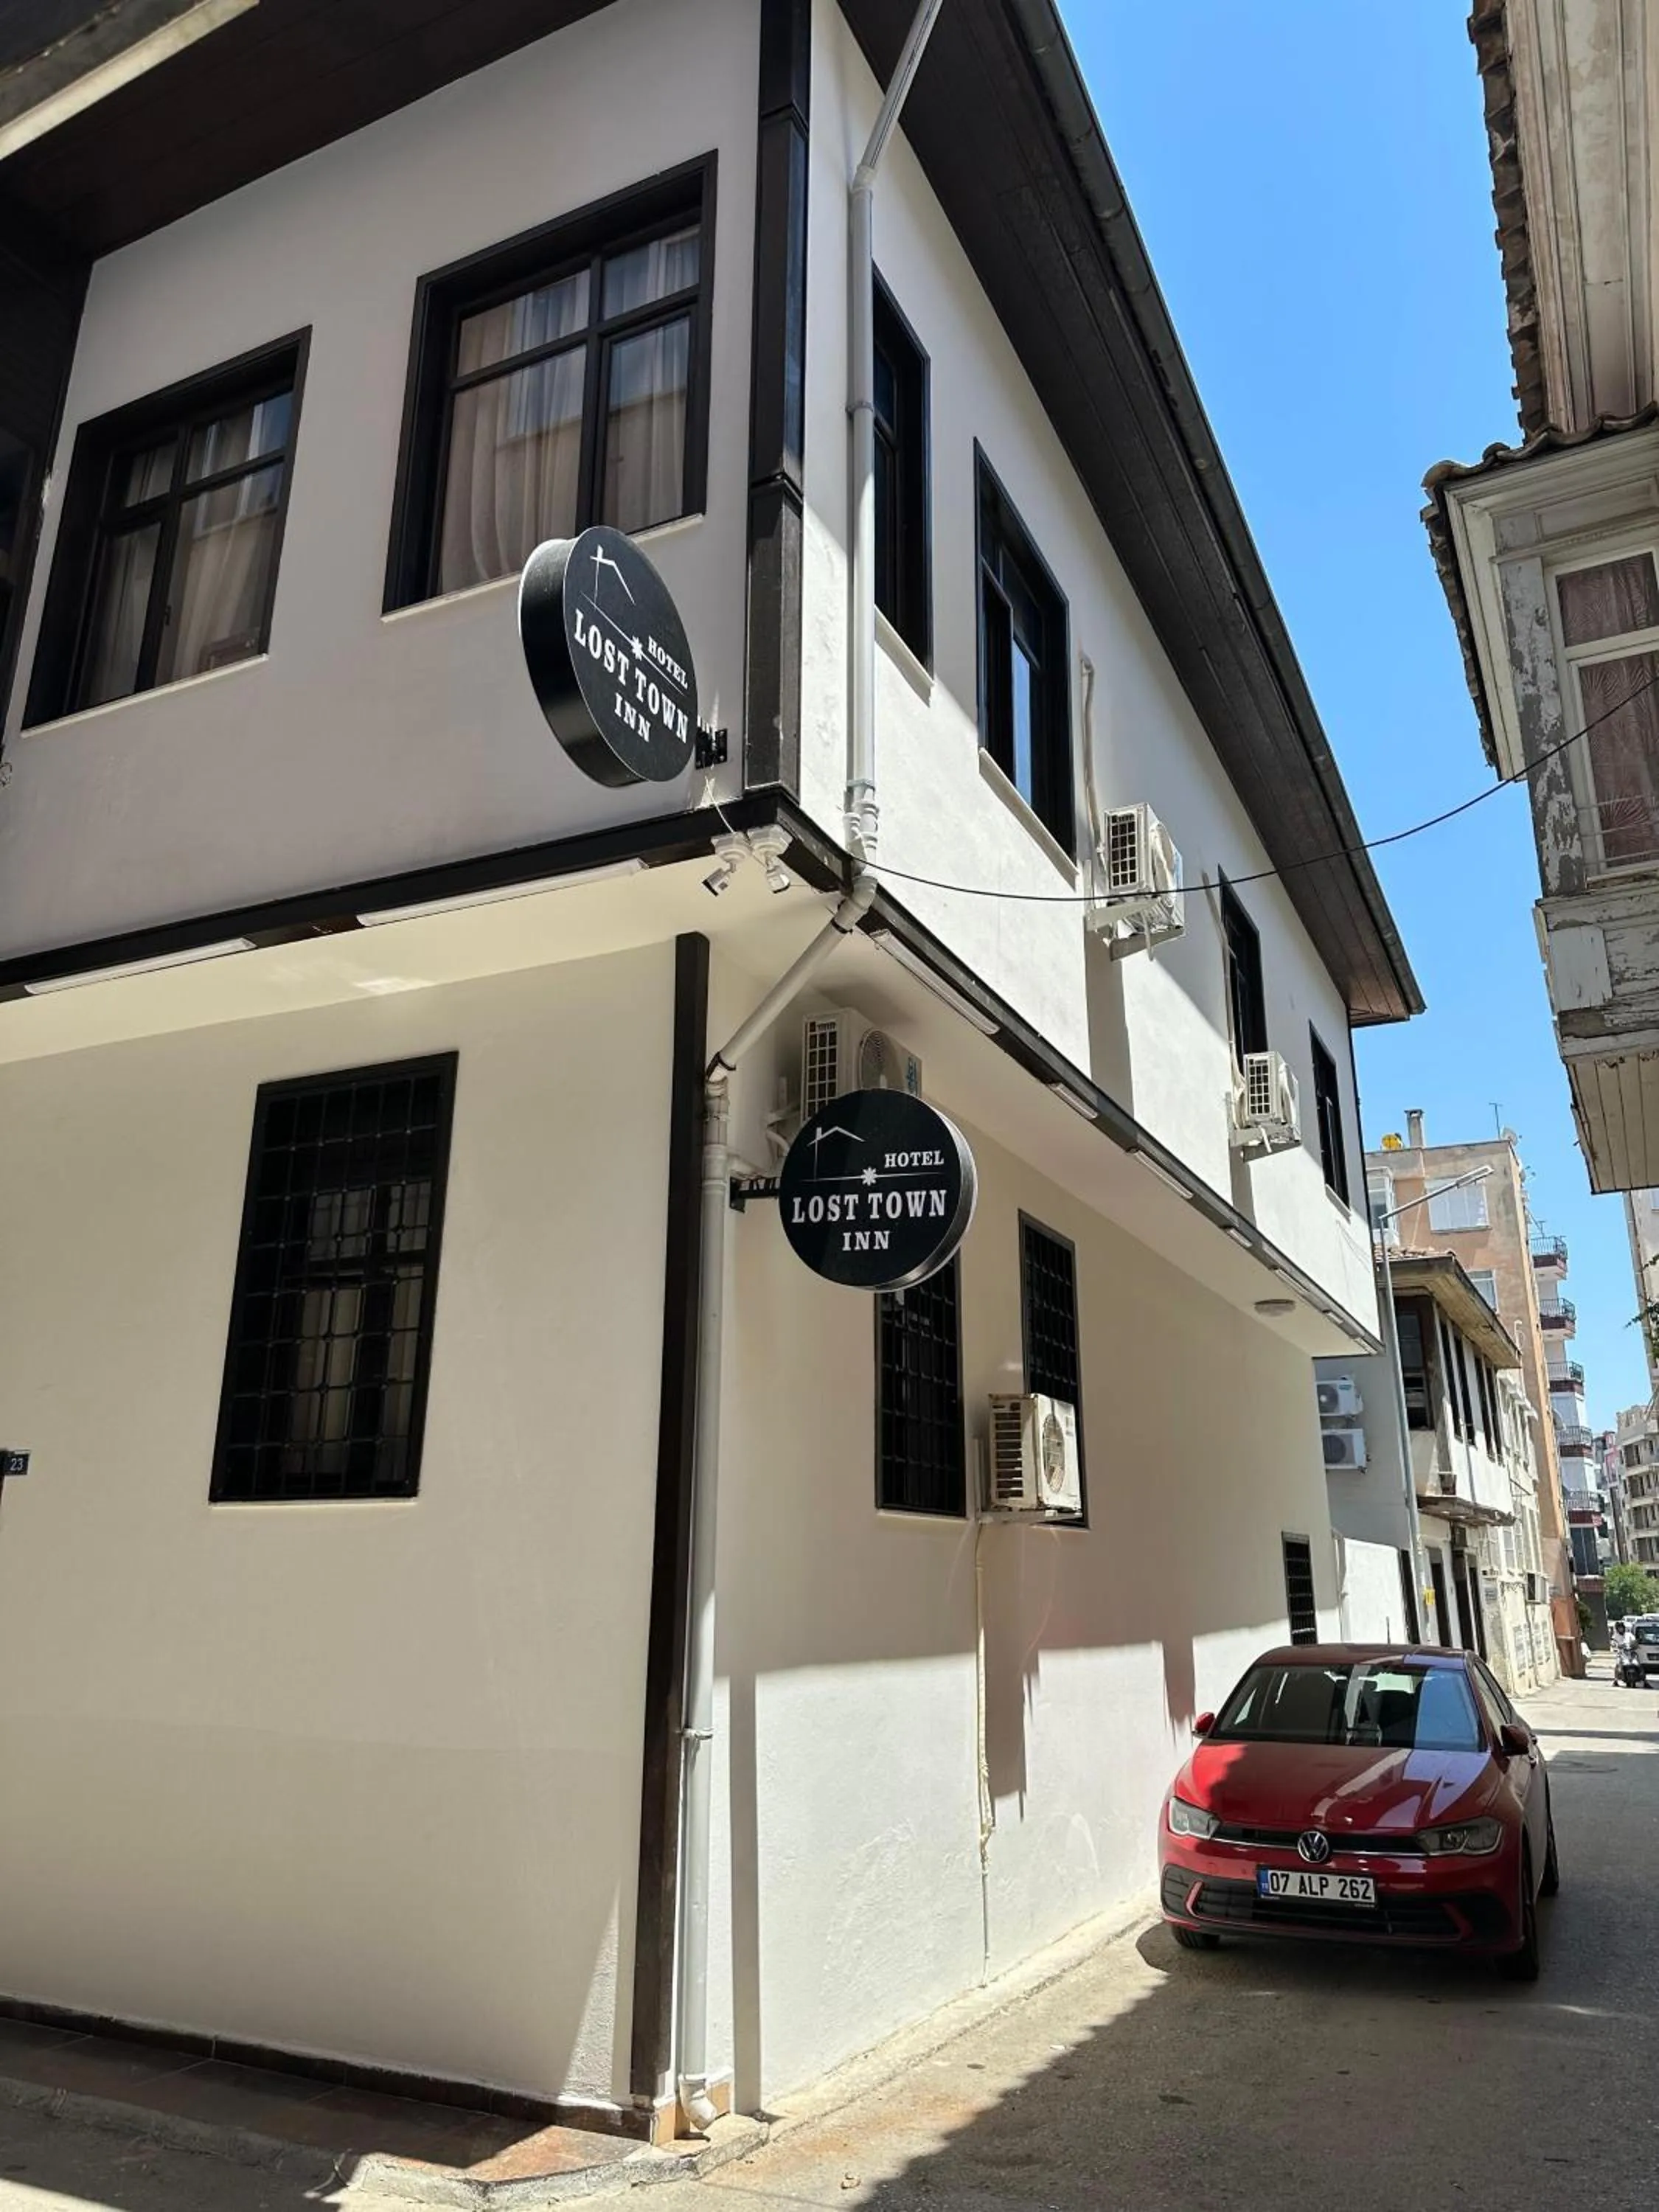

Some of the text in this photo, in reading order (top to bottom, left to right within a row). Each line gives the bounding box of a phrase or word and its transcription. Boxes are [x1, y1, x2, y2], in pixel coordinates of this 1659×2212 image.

[574, 608, 688, 744] LOST TOWN
[648, 636, 688, 689] HOTEL
[614, 692, 651, 742] INN
[884, 1150, 945, 1168] HOTEL
[791, 1189, 947, 1223] LOST TOWN
[842, 1231, 890, 1251] INN
[10, 1458, 24, 1471] 23
[1270, 1872, 1371, 1899] 07 ALP 262
